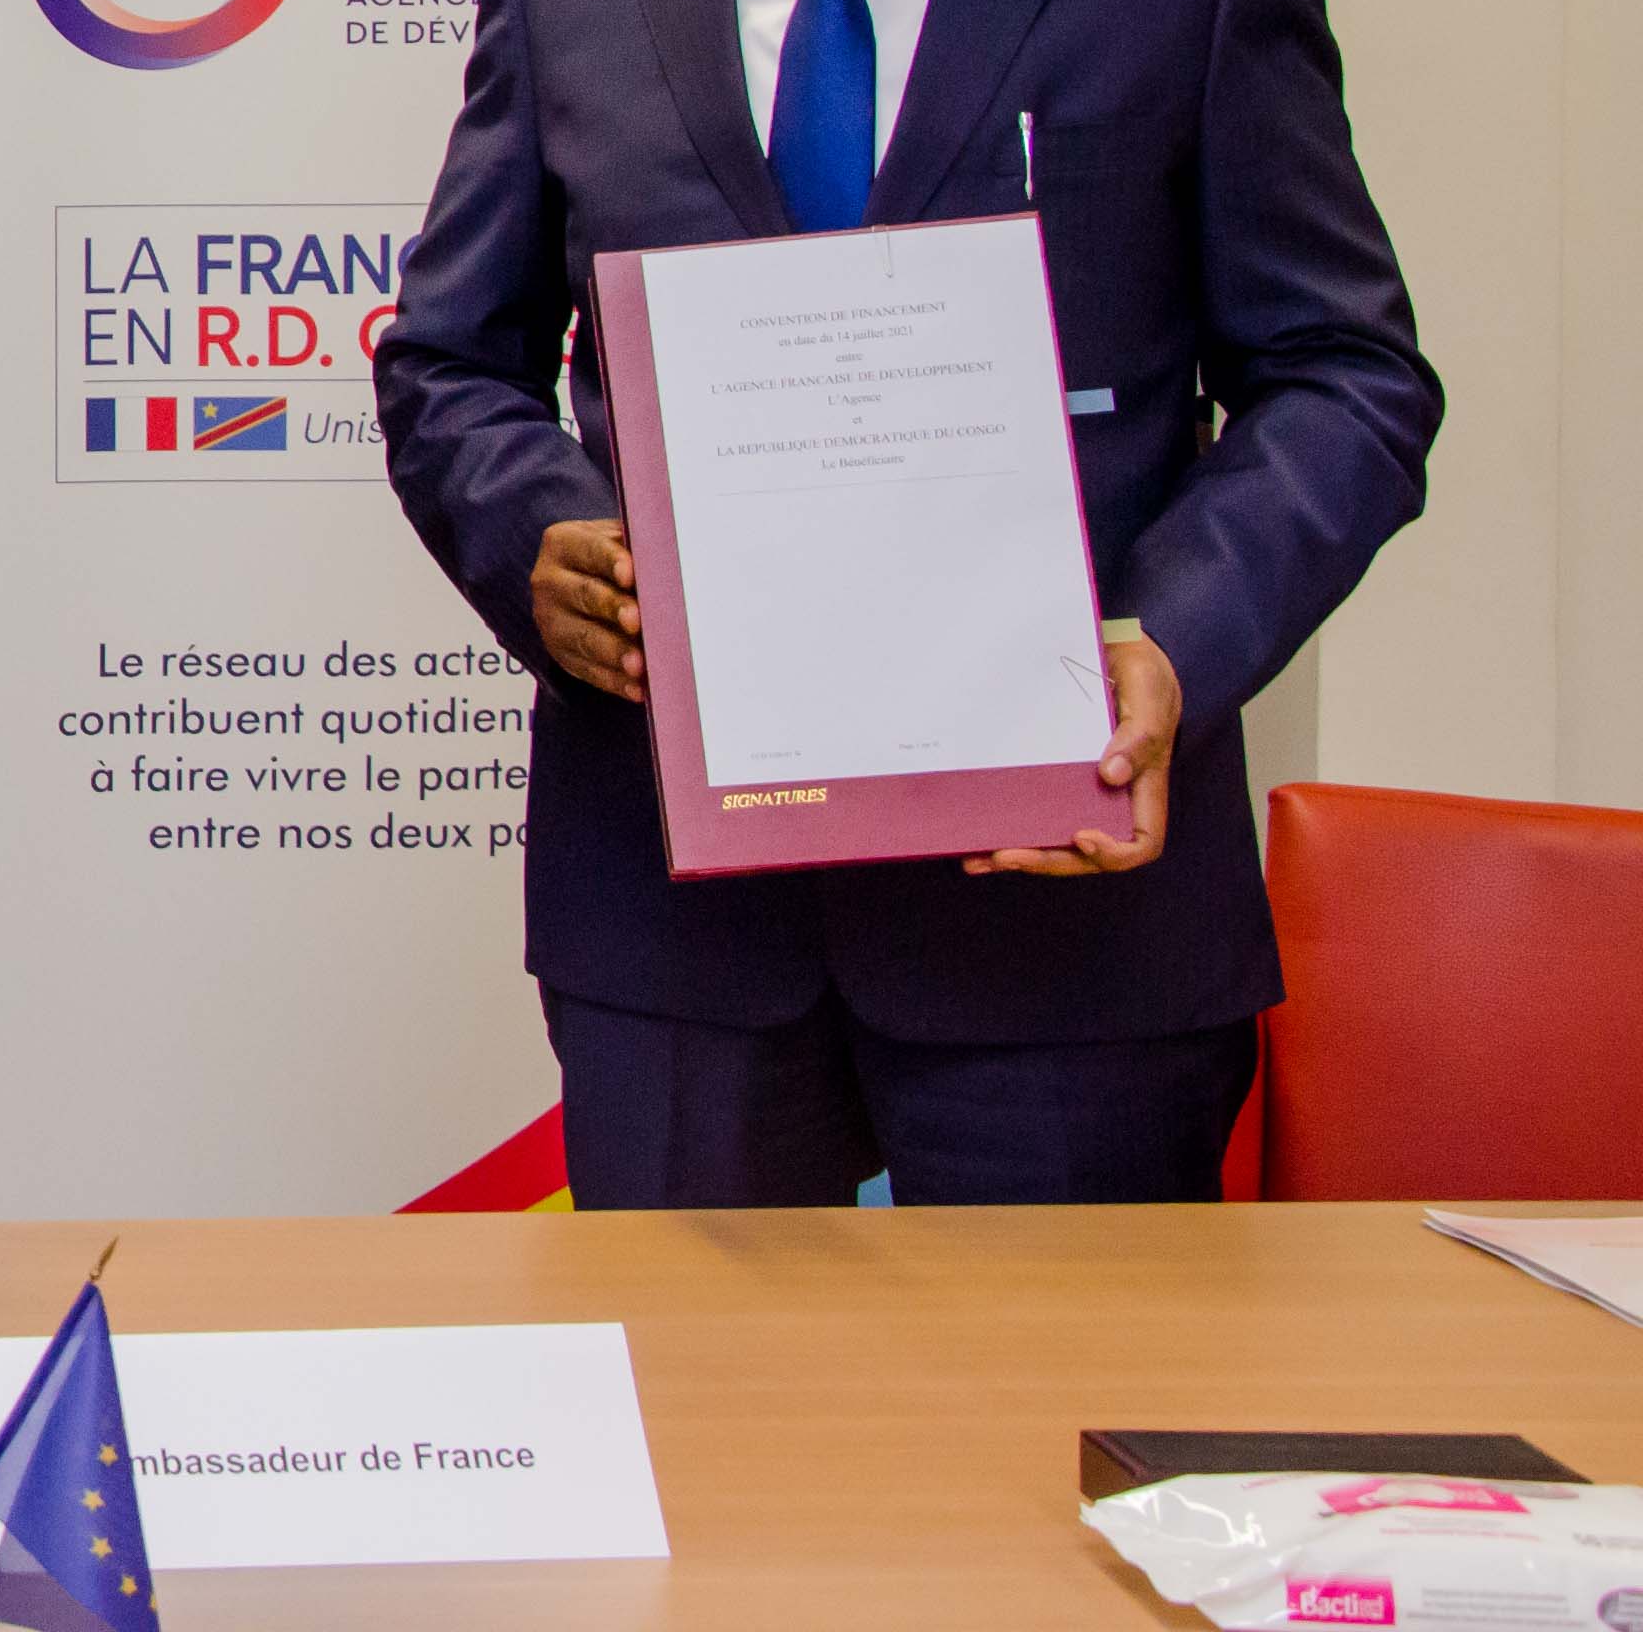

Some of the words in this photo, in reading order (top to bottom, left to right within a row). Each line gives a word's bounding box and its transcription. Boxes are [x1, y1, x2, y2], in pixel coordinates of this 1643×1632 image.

[347, 21, 389, 44] DE
[84, 235, 169, 294] LA
[740, 312, 827, 329] CONVENTION
[830, 310, 847, 321] DE
[851, 301, 947, 320] FINANCEMENT
[85, 308, 171, 365] EN
[197, 307, 332, 367] R.D.
[795, 335, 817, 346] date
[820, 333, 834, 344] du
[837, 331, 850, 342] 14
[852, 328, 884, 343] juillet
[889, 325, 913, 337] 2021
[836, 352, 863, 362] entre
[712, 379, 778, 394] L'AGENCE
[858, 371, 875, 382] DE
[879, 361, 993, 381] DEVELOPPEMENT
[828, 393, 881, 406] L'Agence
[717, 446, 734, 457] LA
[738, 439, 820, 456] REPUBLIQUE
[824, 431, 931, 449] DEMOCRATIQUE
[935, 428, 954, 439] DU
[957, 423, 1006, 438] CONGO
[98, 643, 143, 678] Le
[161, 644, 305, 678] réseau
[323, 640, 397, 678] des
[58, 697, 304, 736] contribuent
[90, 760, 114, 792] à
[132, 755, 228, 791] faire
[244, 756, 347, 791] vivre
[365, 754, 400, 791] le
[722, 787, 827, 810] SIGNATURES
[149, 817, 260, 850] entre
[278, 823, 352, 850] nos
[369, 812, 473, 849] deux
[130, 1445, 347, 1477] mbassadeur
[360, 1444, 401, 1472] de
[413, 1441, 535, 1470] France
